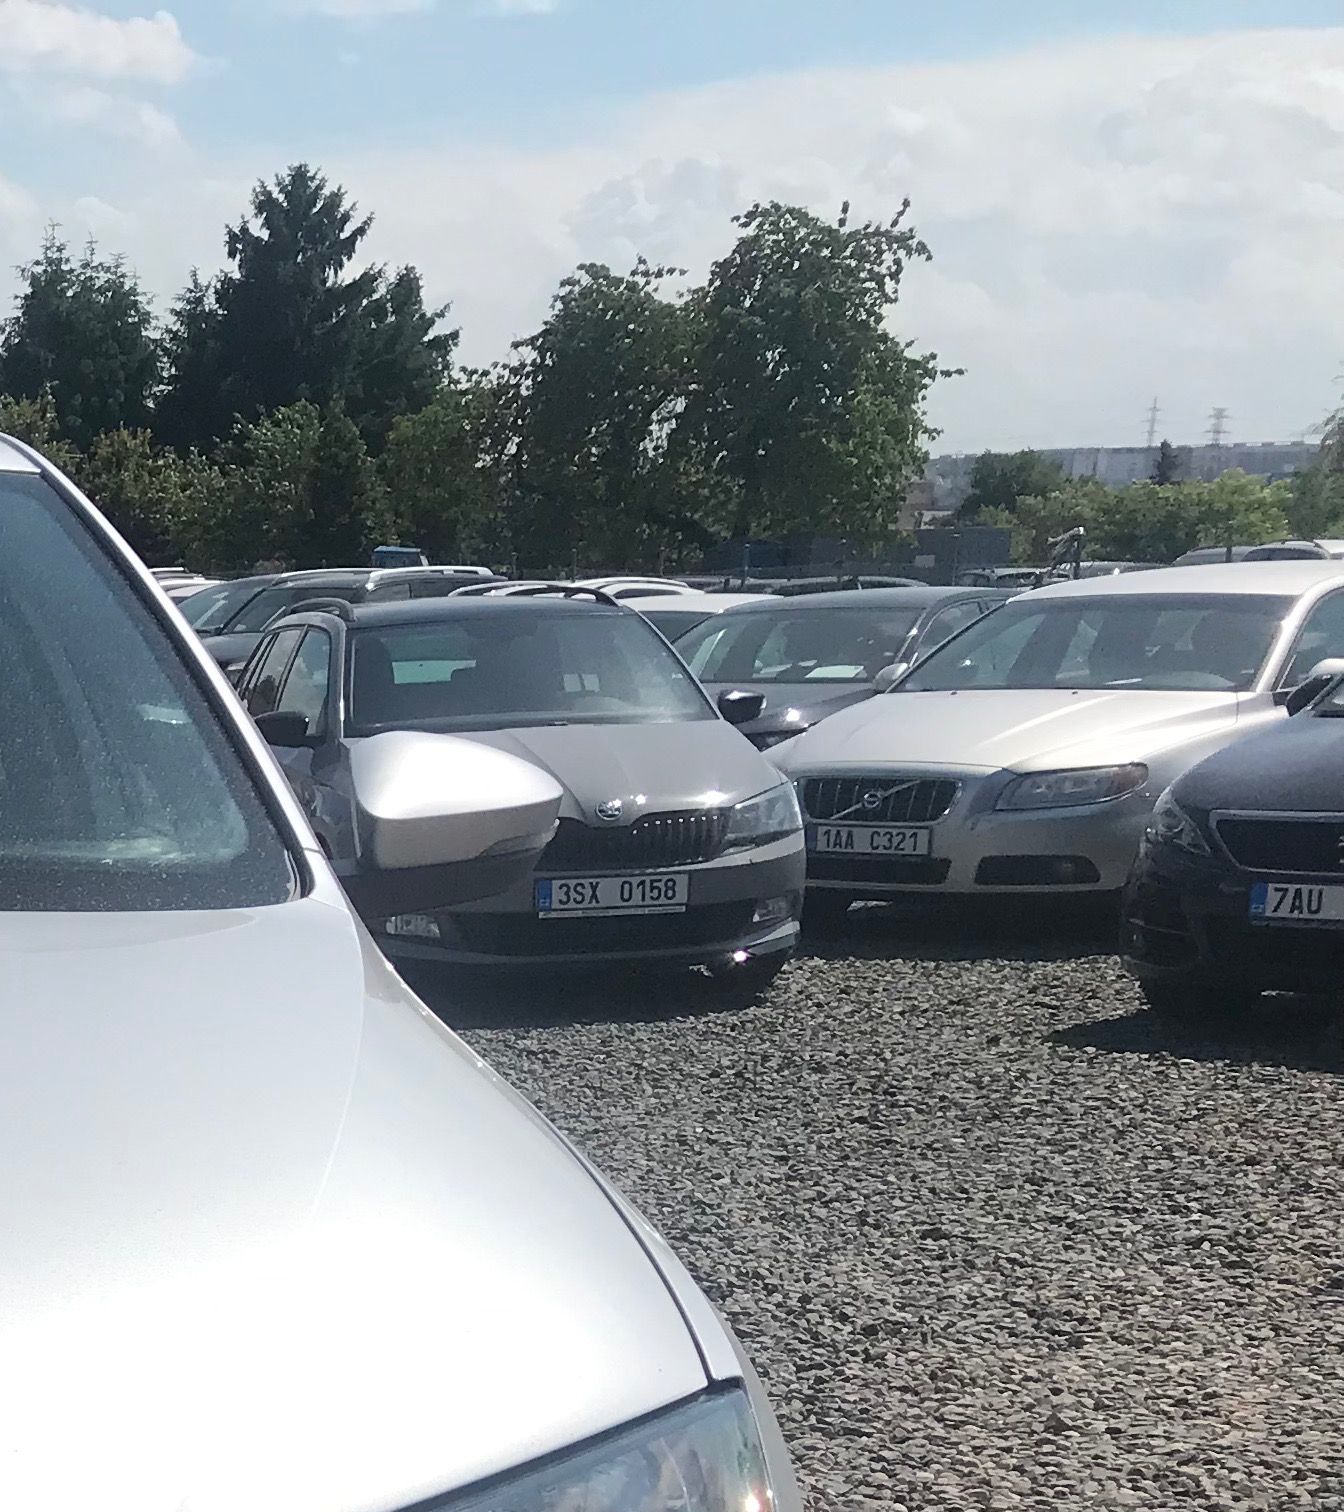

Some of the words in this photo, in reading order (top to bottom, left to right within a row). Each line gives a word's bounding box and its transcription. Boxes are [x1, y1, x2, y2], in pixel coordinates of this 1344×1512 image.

[823, 829, 854, 850] 1AA
[870, 831, 918, 852] C321
[558, 881, 600, 905] 3SX
[620, 878, 677, 902] 0158
[1272, 887, 1323, 915] 7AU
